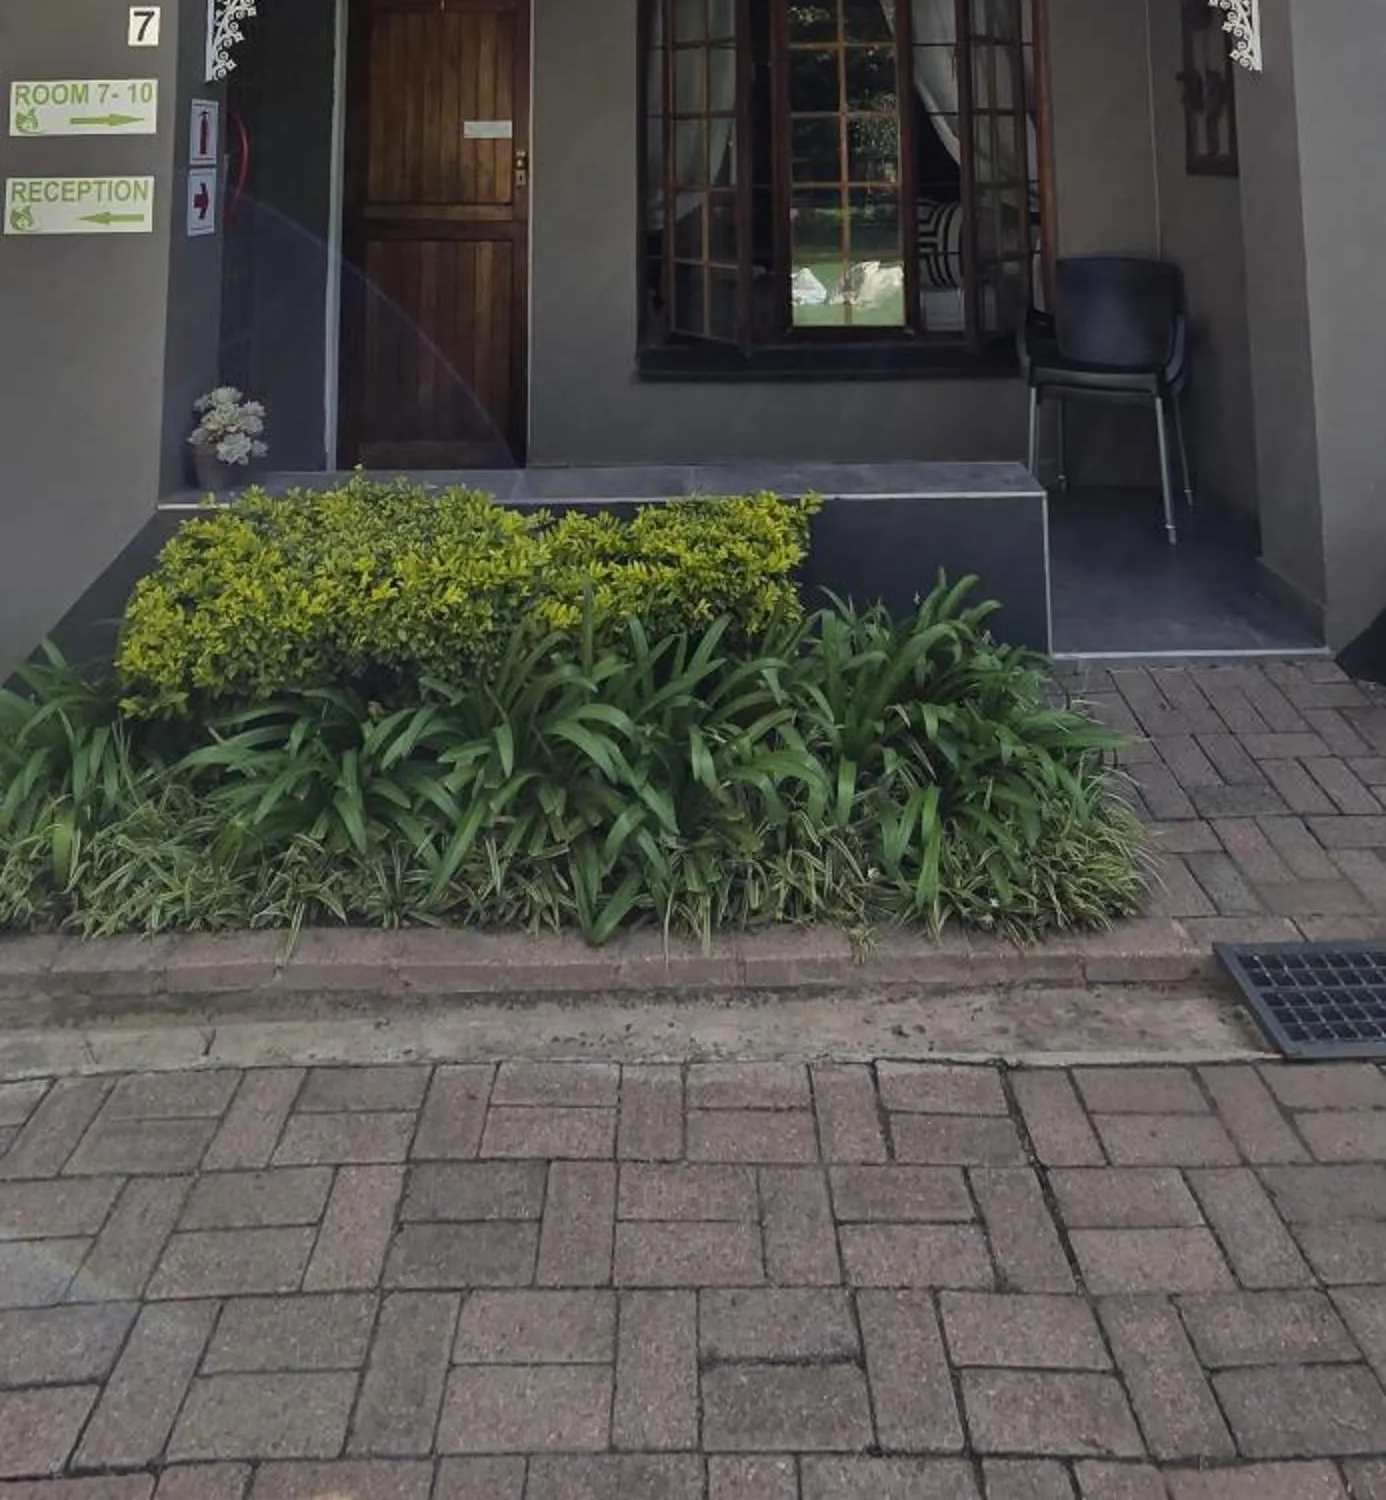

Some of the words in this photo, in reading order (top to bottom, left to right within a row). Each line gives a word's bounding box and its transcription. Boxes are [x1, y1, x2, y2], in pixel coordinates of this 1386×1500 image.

[133, 11, 155, 42] 7
[15, 83, 89, 105] ROOM
[127, 82, 153, 103] 10
[11, 180, 148, 202] RECEPTION
